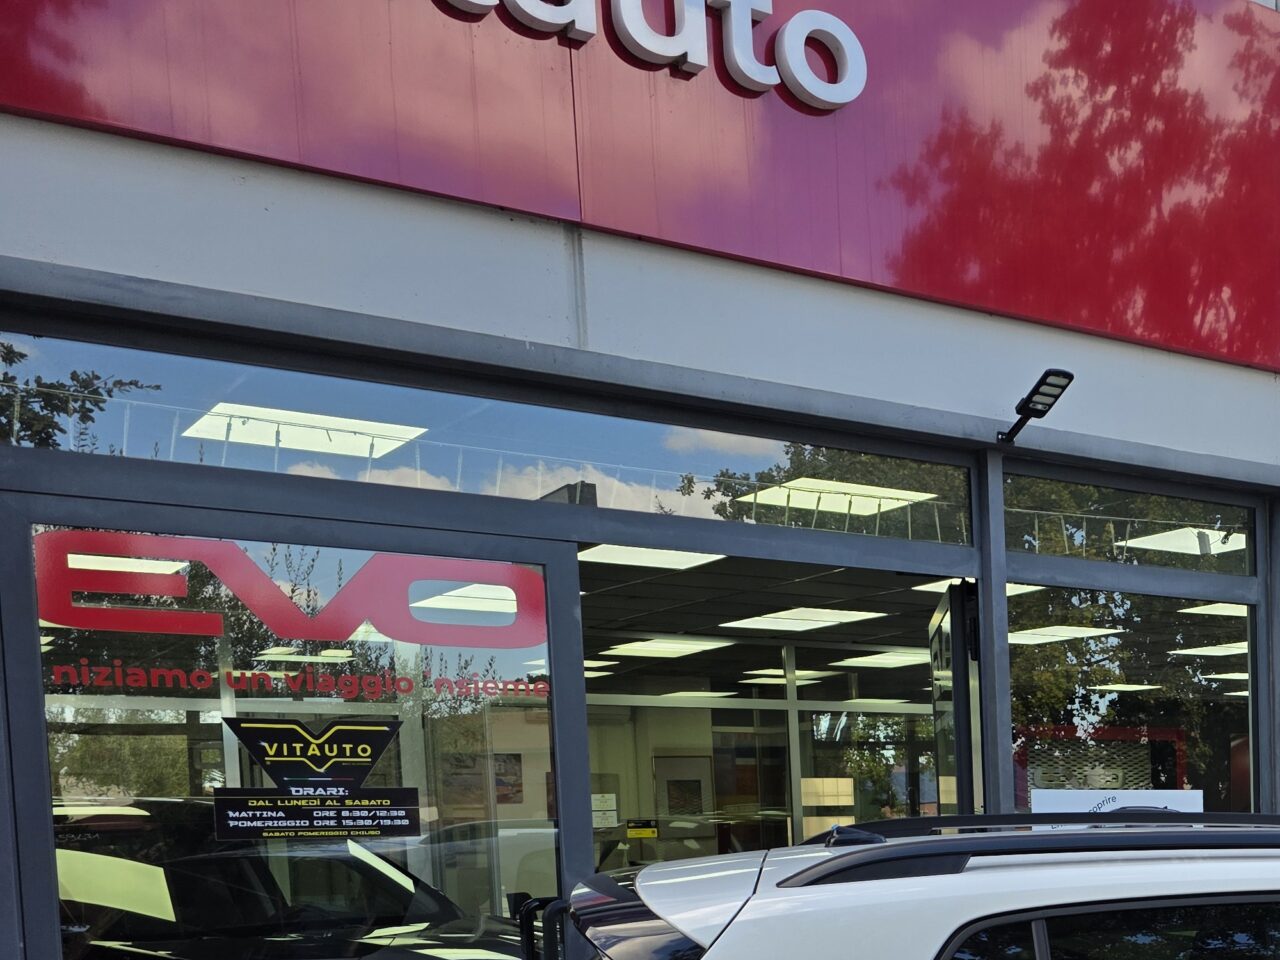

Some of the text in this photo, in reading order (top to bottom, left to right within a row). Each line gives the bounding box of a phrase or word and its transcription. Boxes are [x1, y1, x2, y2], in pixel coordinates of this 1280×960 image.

[34, 528, 548, 649] EVO
[225, 670, 273, 691] un
[284, 665, 415, 700] viaggio
[264, 743, 372, 757] VITAUTO
[290, 786, 349, 796] ORARI:
[226, 810, 286, 818] MATTINA
[227, 820, 309, 828] POMERIGGIO
